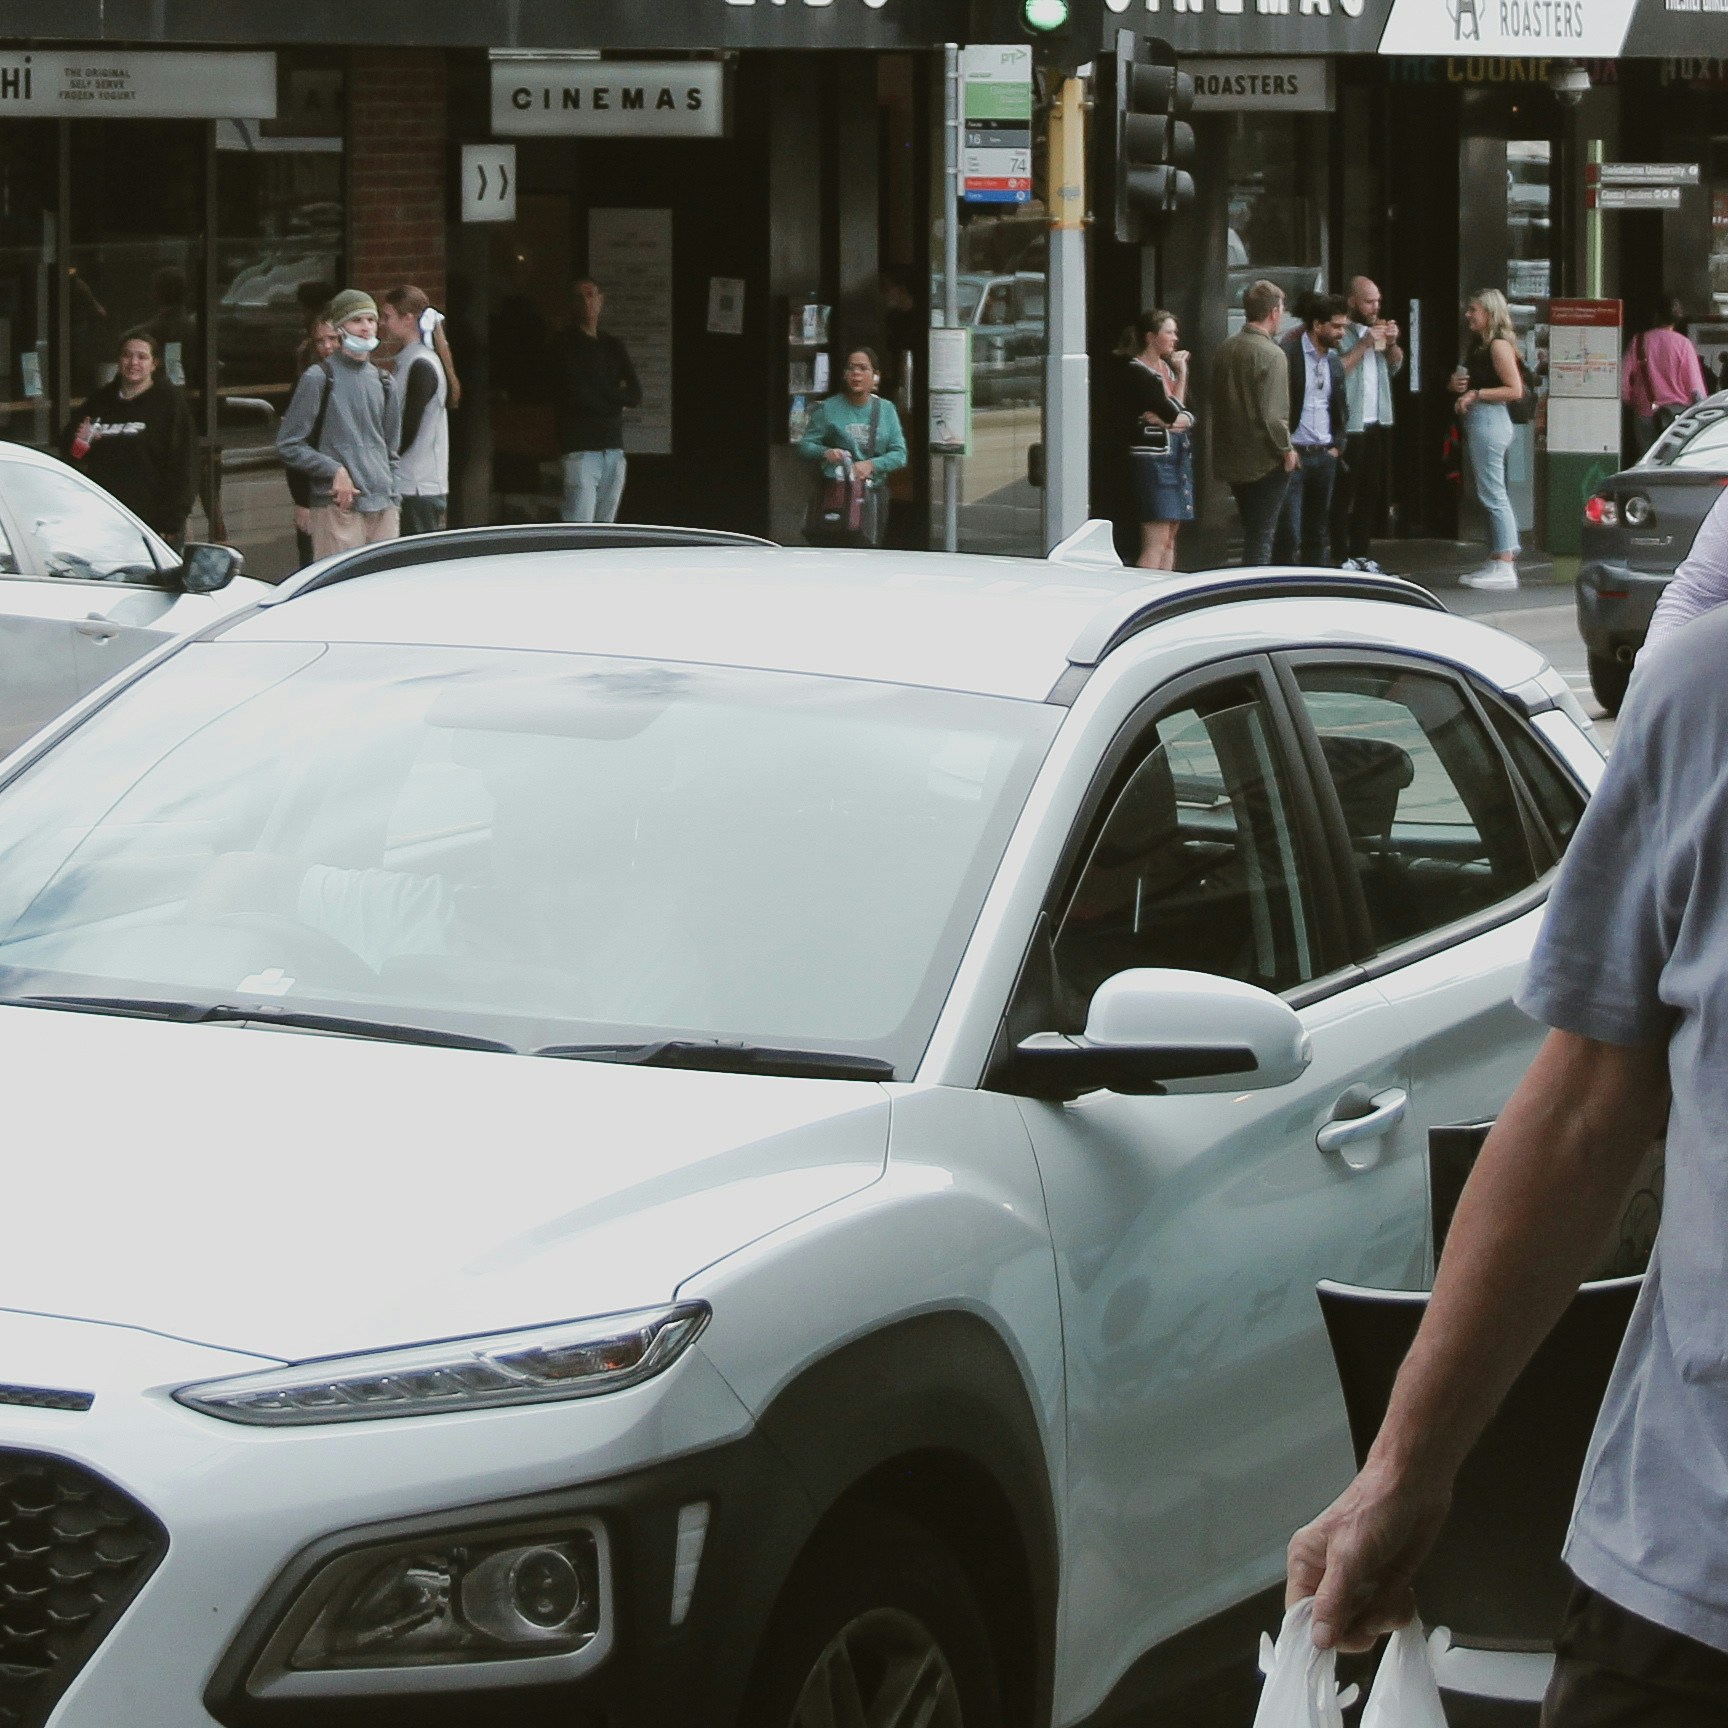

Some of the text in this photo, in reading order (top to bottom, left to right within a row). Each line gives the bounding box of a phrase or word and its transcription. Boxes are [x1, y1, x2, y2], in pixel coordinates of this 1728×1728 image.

[1499, 0, 1584, 40] ROASTERS
[1193, 73, 1299, 96] ROASTERS
[512, 87, 703, 111] CINEMAS
[1010, 158, 1027, 173] 74
